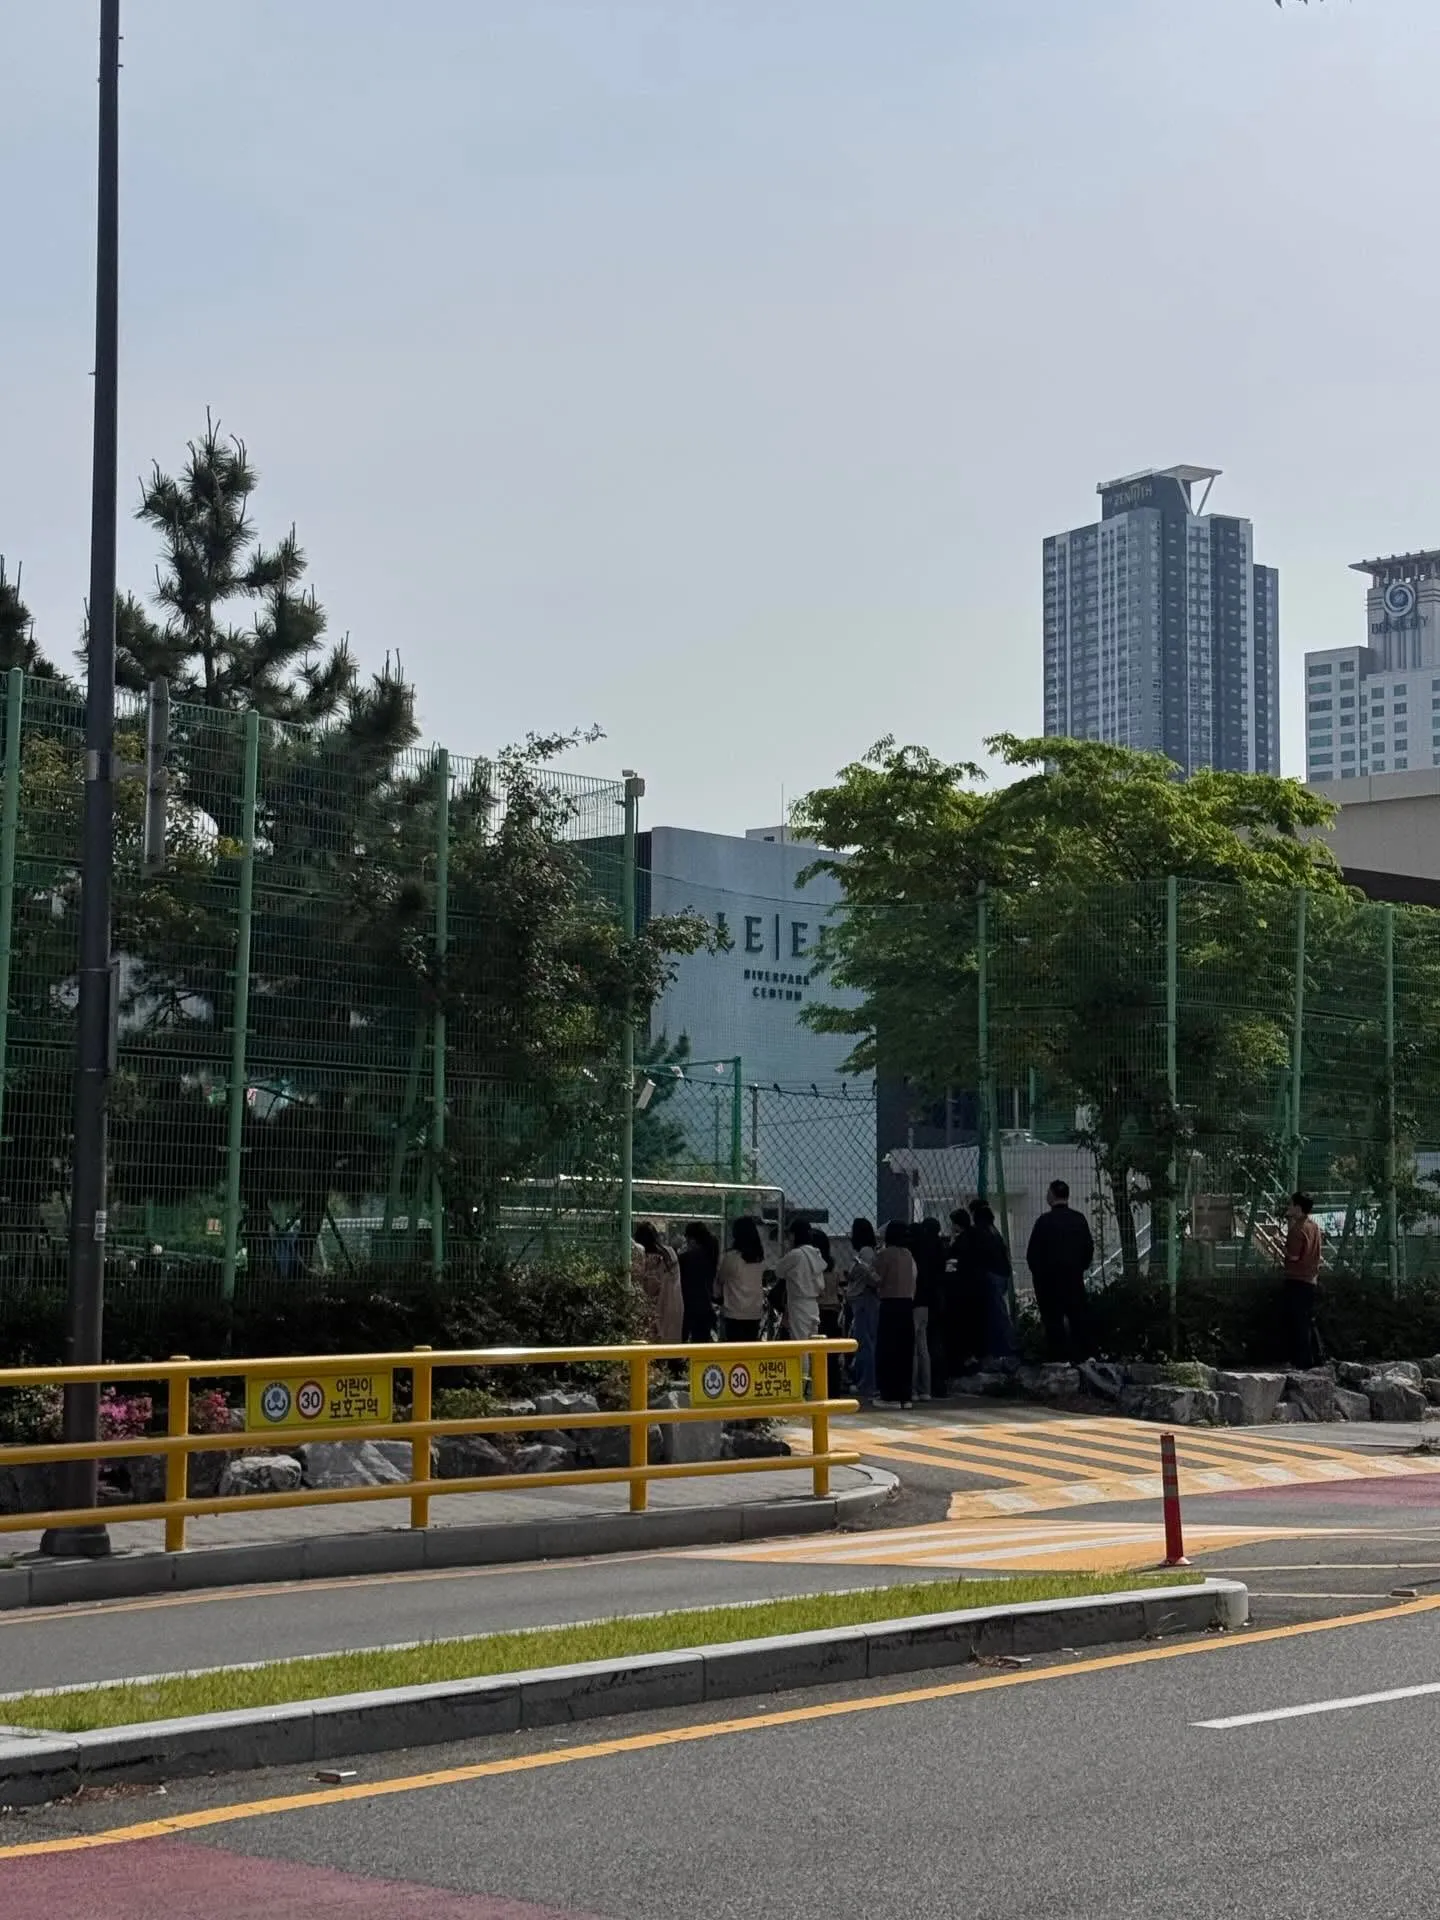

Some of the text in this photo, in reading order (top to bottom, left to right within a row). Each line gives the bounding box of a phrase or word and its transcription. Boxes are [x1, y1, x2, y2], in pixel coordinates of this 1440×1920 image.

[758, 1360, 787, 1379] 어린이
[335, 1377, 373, 1398] 어린이
[732, 1373, 747, 1388] 30
[754, 1379, 792, 1397] 보호구역
[301, 1391, 320, 1409] 30
[329, 1398, 378, 1418] 보호구역
